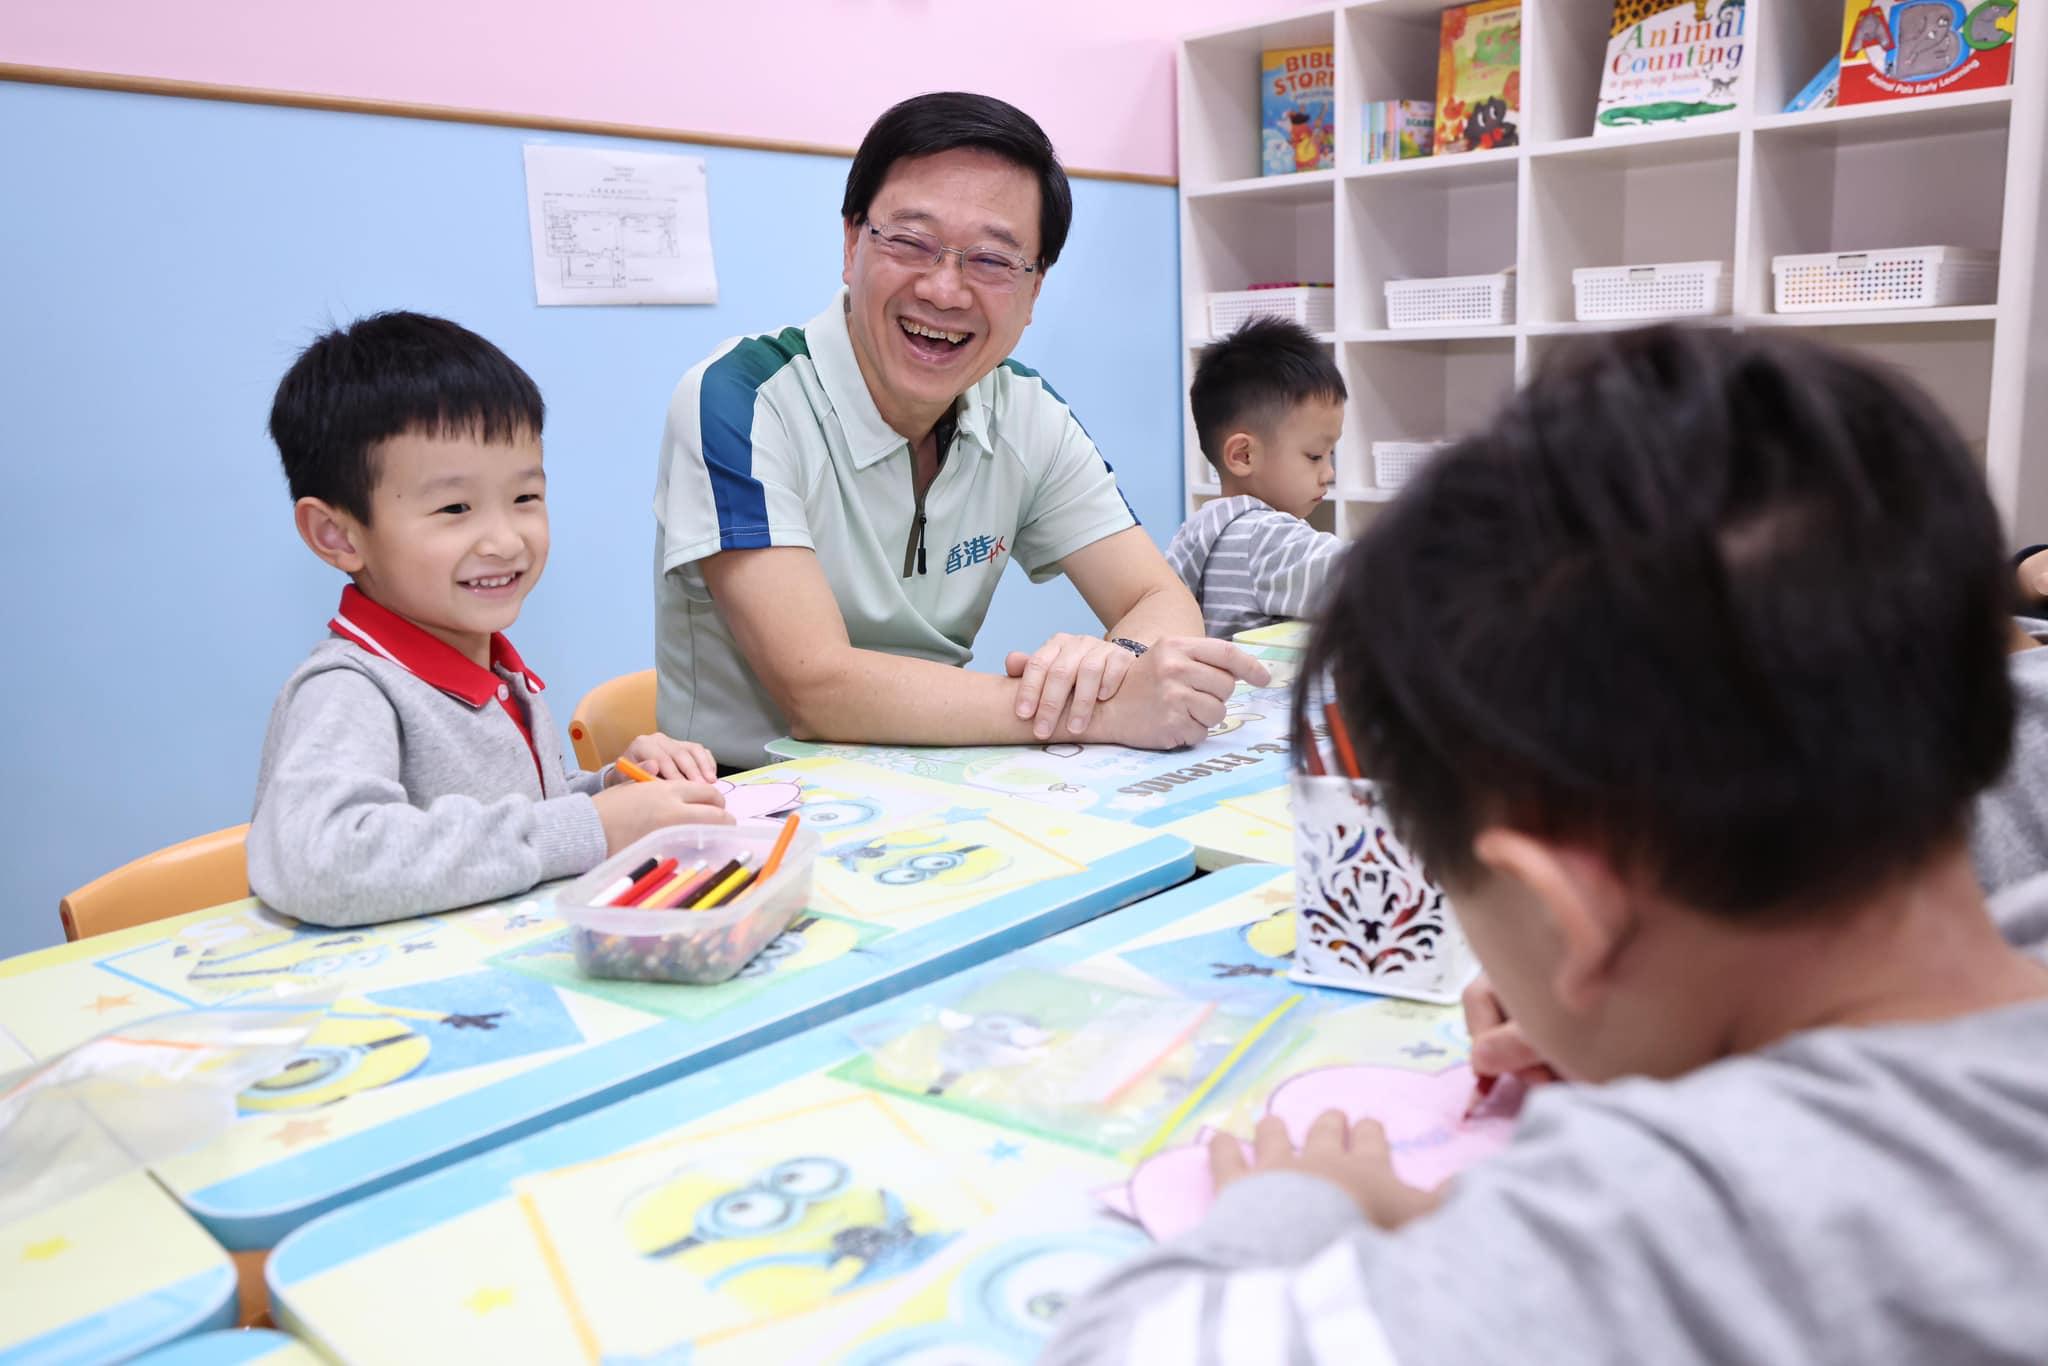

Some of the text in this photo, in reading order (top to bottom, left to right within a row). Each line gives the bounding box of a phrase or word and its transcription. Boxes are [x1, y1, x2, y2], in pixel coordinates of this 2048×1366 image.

[1621, 7, 1745, 51] Animal
[1844, 0, 2017, 82] ABC
[1611, 44, 1744, 76] Counting
[1117, 752, 1265, 797] Friends
